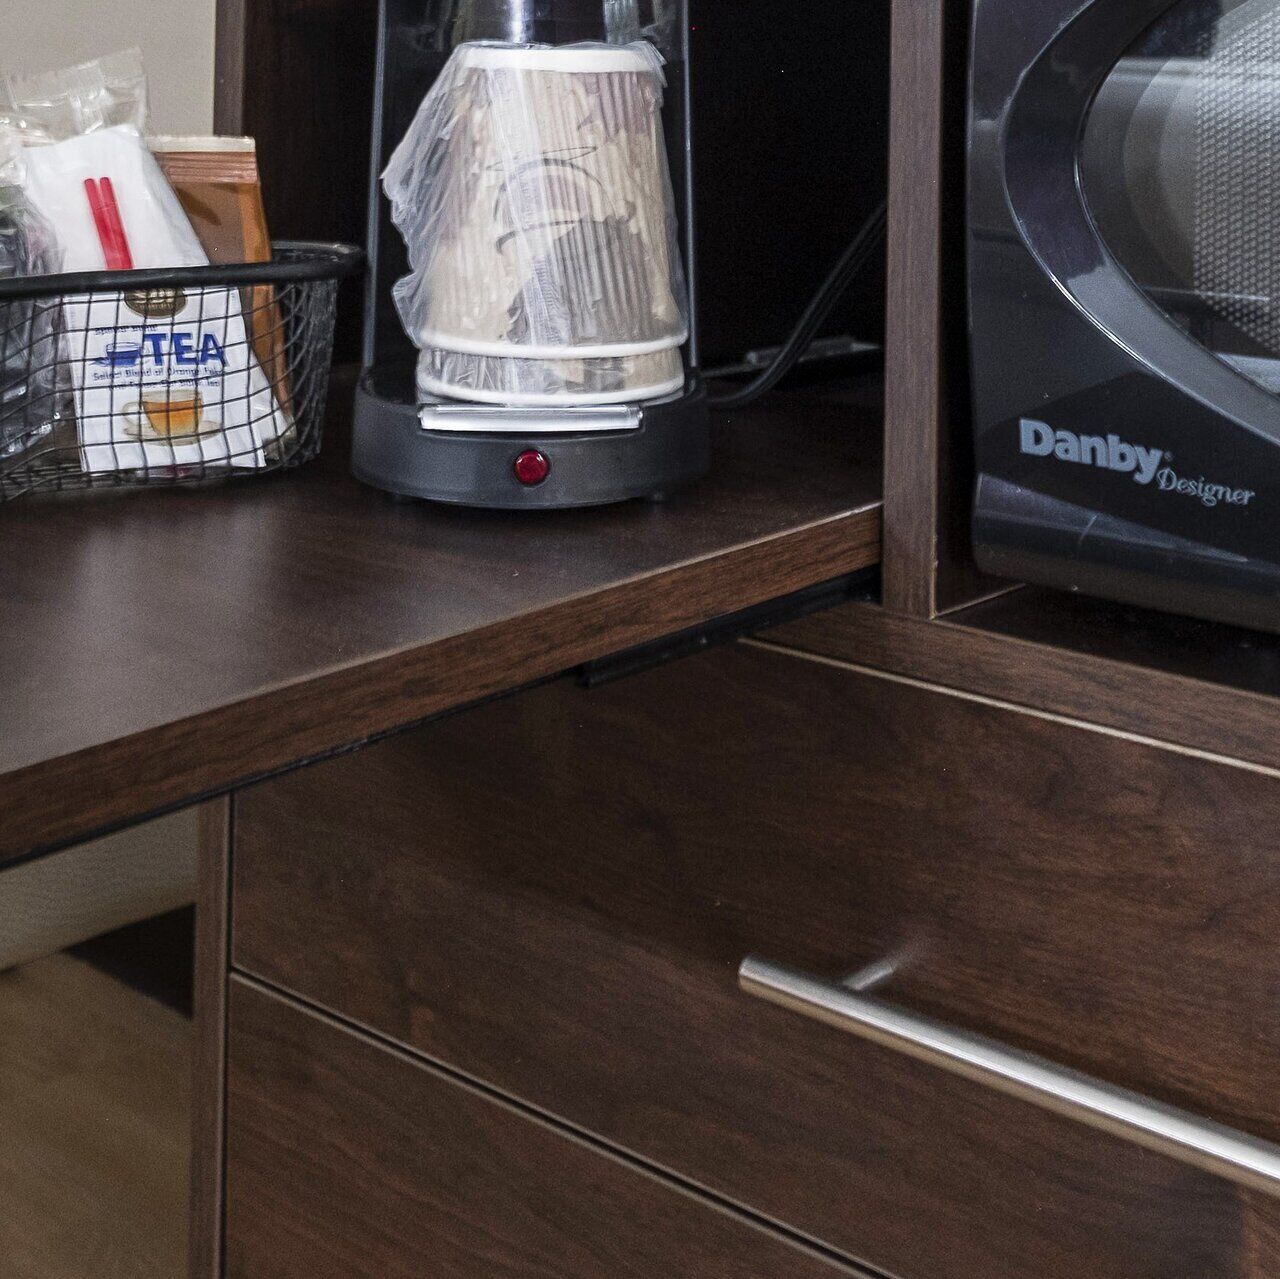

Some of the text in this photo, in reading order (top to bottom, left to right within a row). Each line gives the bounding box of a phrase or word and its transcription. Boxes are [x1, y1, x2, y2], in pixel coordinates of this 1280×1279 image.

[143, 332, 228, 367] TEA
[1019, 418, 1257, 507] Danby Designer
